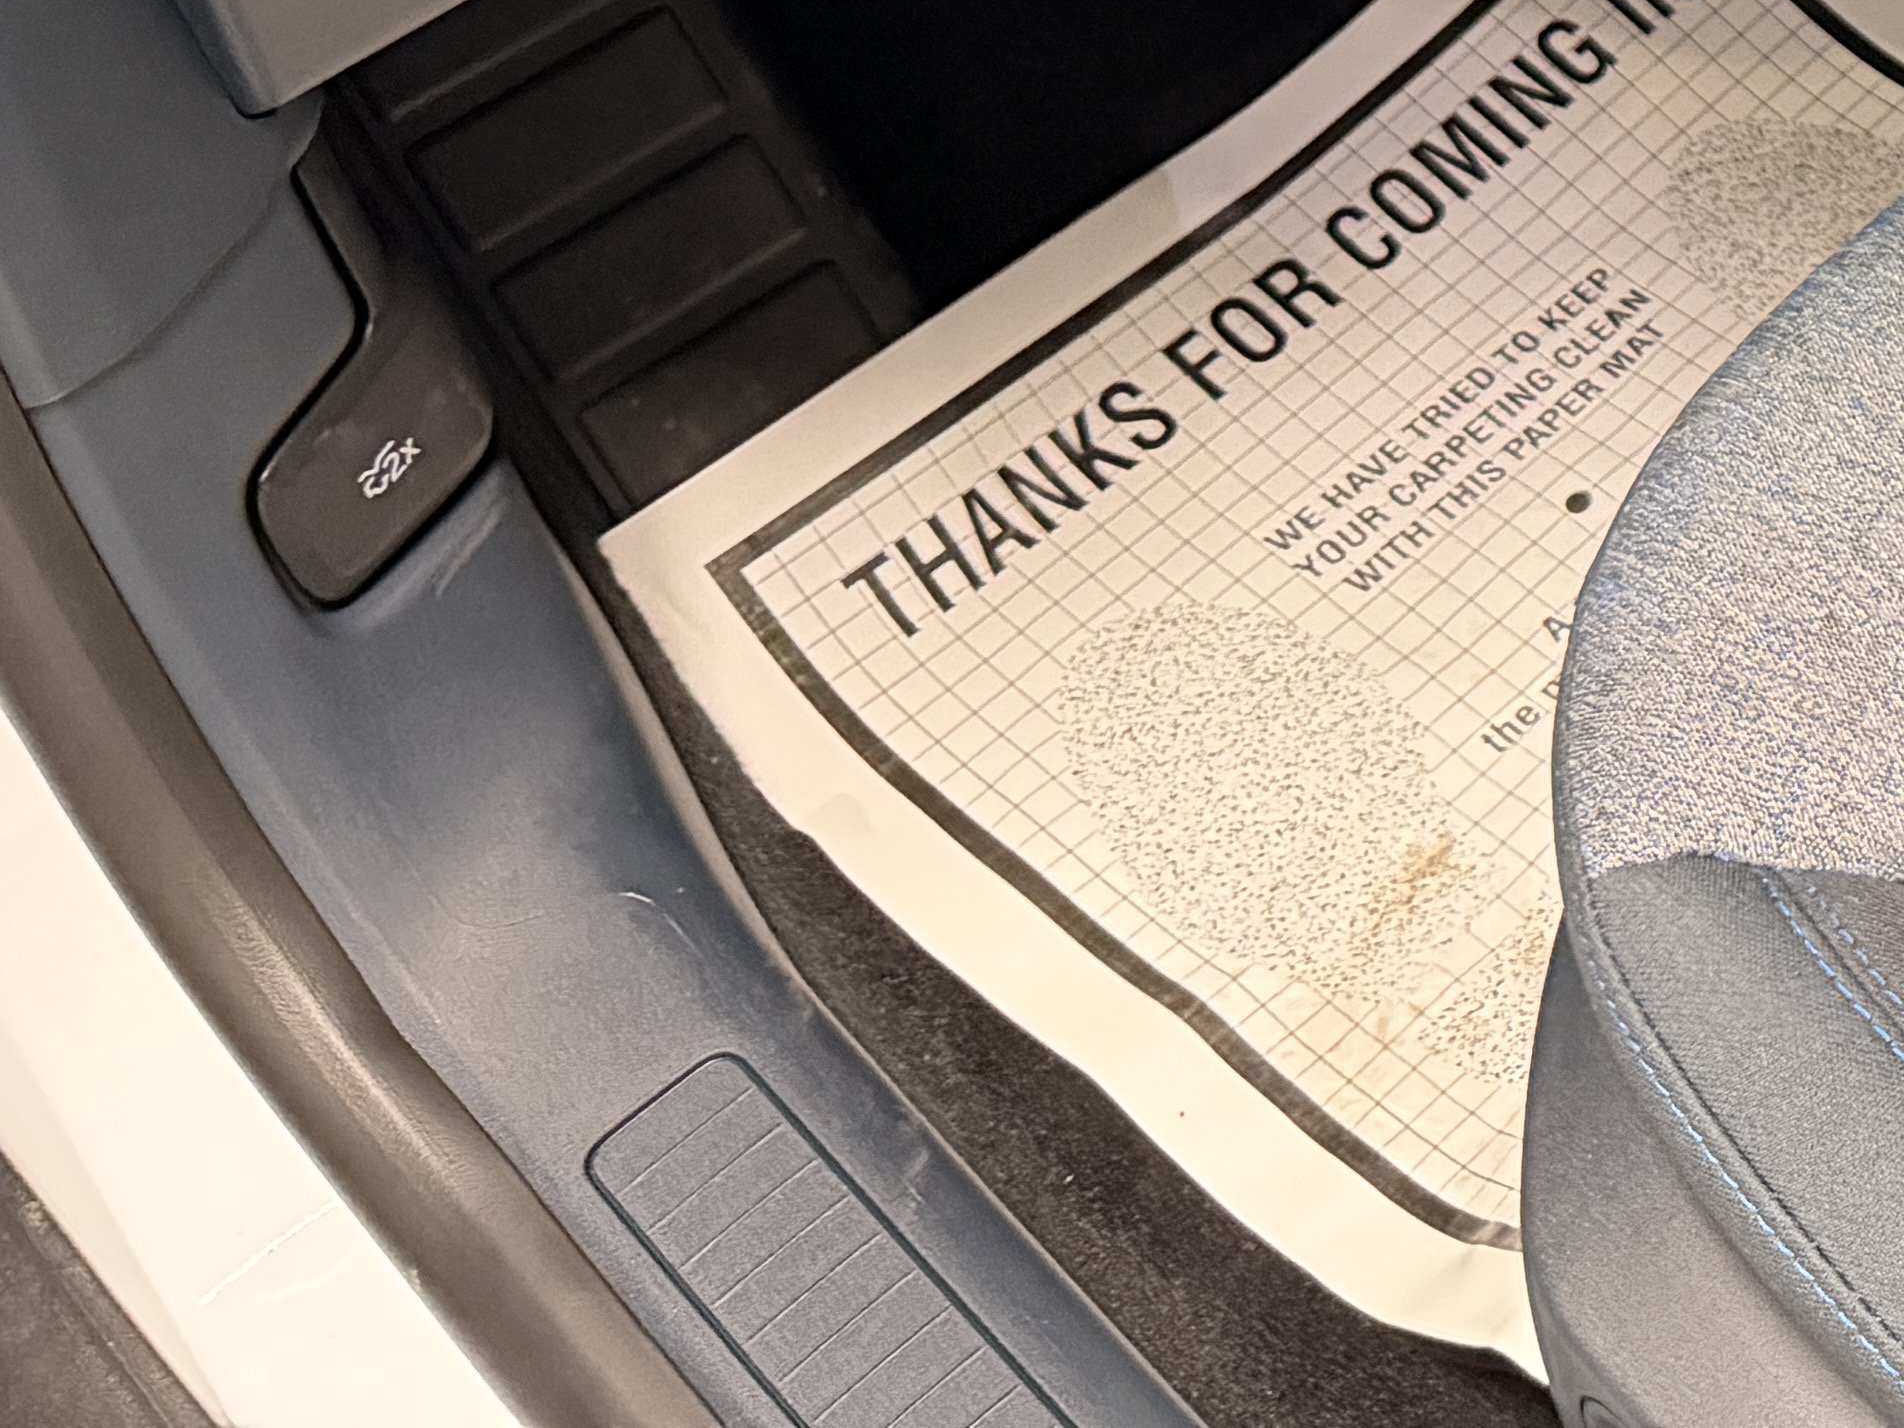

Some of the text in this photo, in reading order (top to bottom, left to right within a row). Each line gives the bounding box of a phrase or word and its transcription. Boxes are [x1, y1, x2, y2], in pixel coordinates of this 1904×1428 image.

[841, 381, 1178, 638] THANKS
[1163, 257, 1344, 402] FOR
[1326, 19, 1619, 269] COMING
[1263, 267, 1611, 551] WE HAVE TRIED TO KEEP
[1293, 288, 1653, 579] YOUR CARPETING CLEAN
[1342, 322, 1664, 593] WITH THIS PAPER MAT
[1481, 705, 1541, 753] the
